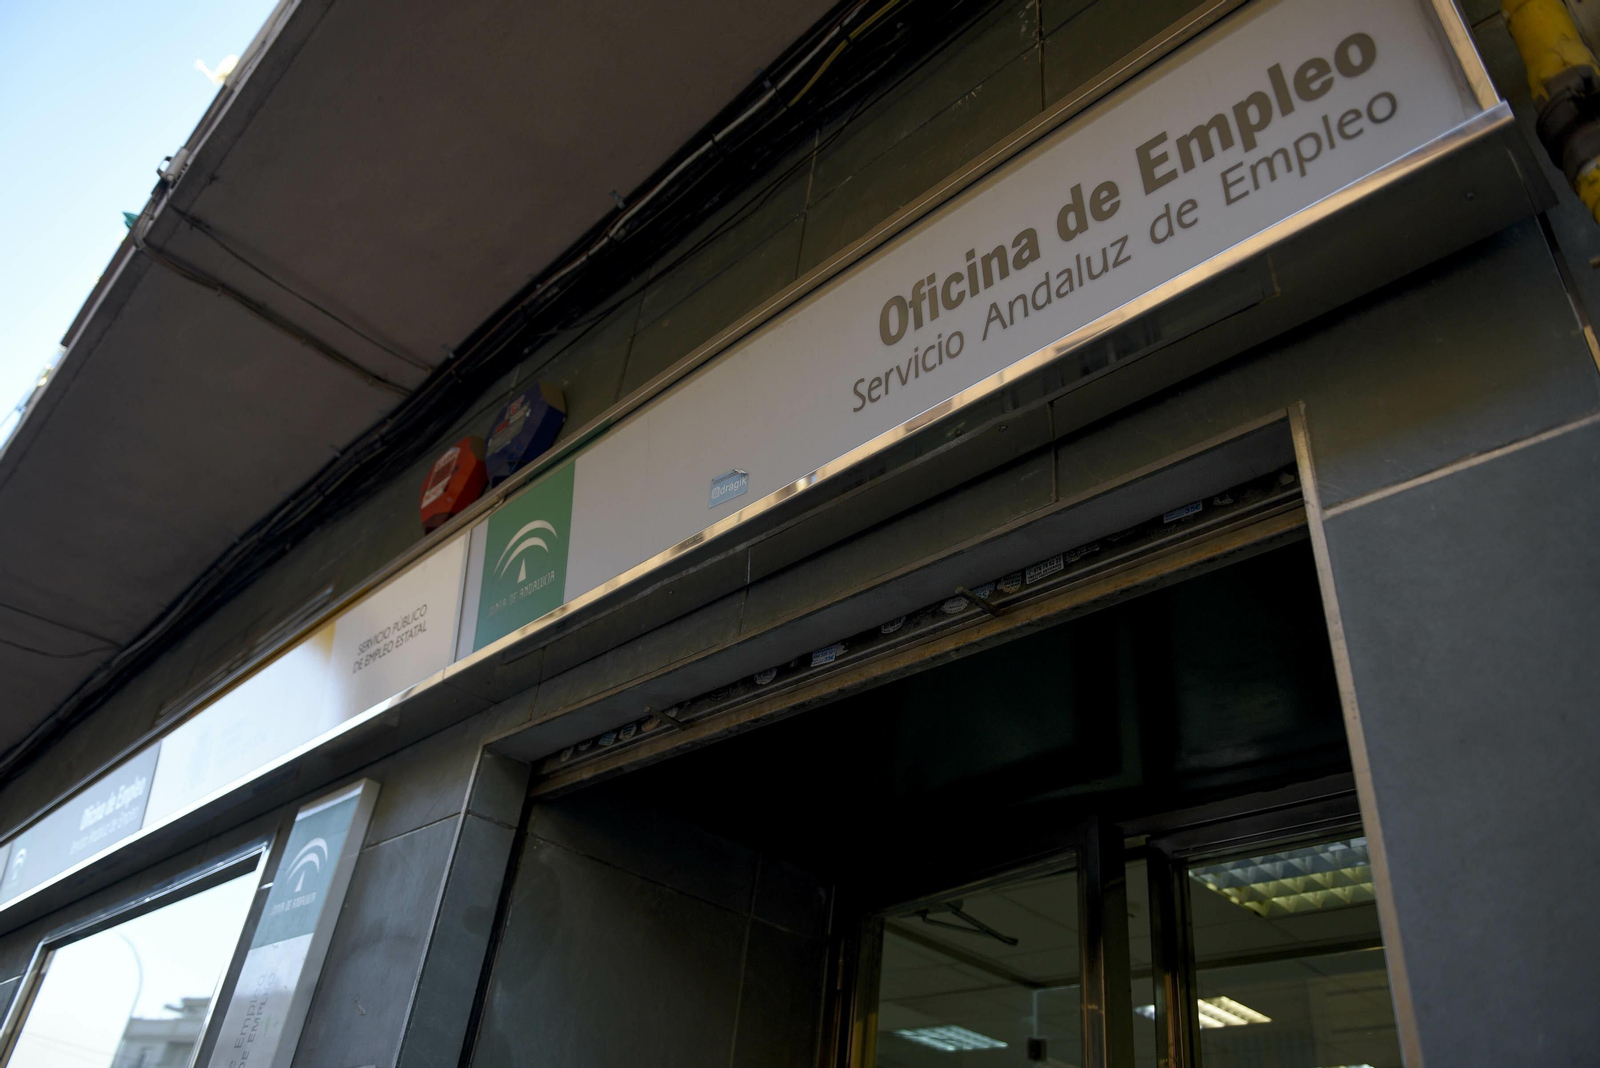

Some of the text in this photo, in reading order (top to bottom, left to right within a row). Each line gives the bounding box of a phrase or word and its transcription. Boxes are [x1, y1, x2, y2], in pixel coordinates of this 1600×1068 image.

[851, 90, 1399, 413] Servicio Andaluz de Empleo
[879, 31, 1377, 346] Oficina de Empleo
[352, 620, 428, 674] DE EMPLEO ESTATAL
[357, 627, 391, 656] SERVICIO
